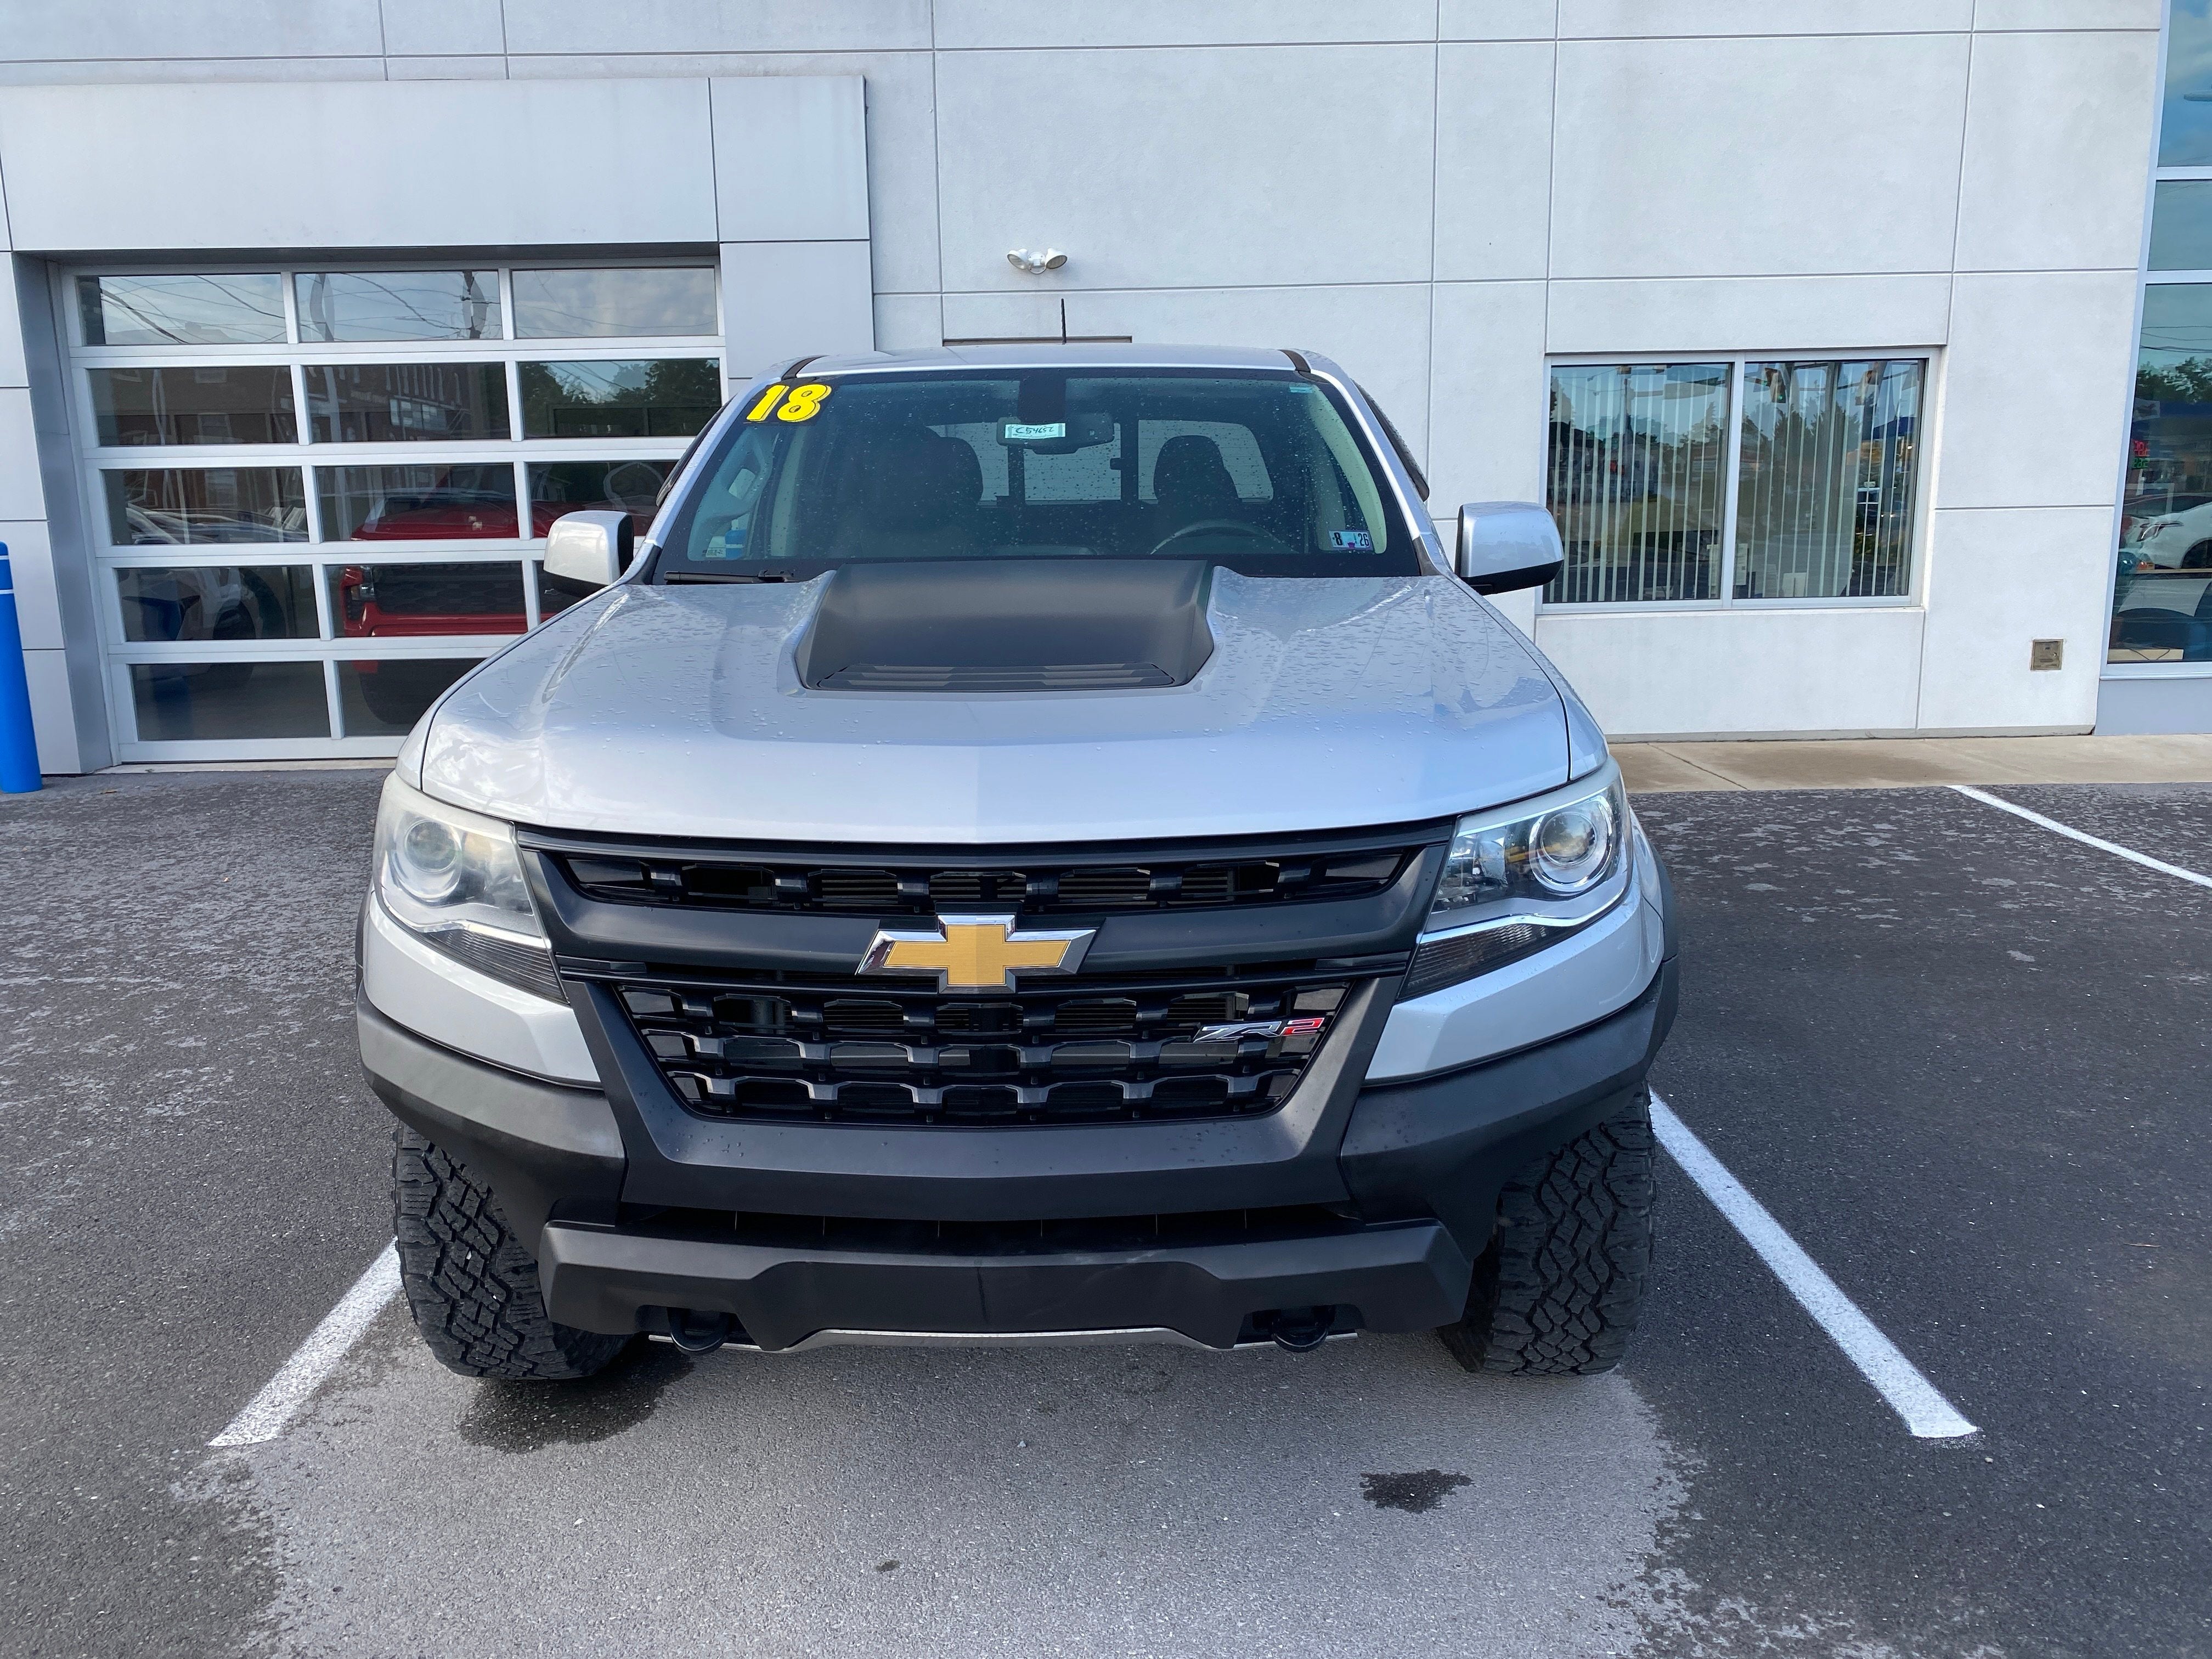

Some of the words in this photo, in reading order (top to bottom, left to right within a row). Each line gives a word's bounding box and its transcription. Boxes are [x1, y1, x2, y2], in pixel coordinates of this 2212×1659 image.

[747, 383, 832, 422] 18
[1334, 532, 1343, 546] 8
[1357, 533, 1369, 546] 26
[1193, 1017, 1325, 1043] ZR2
